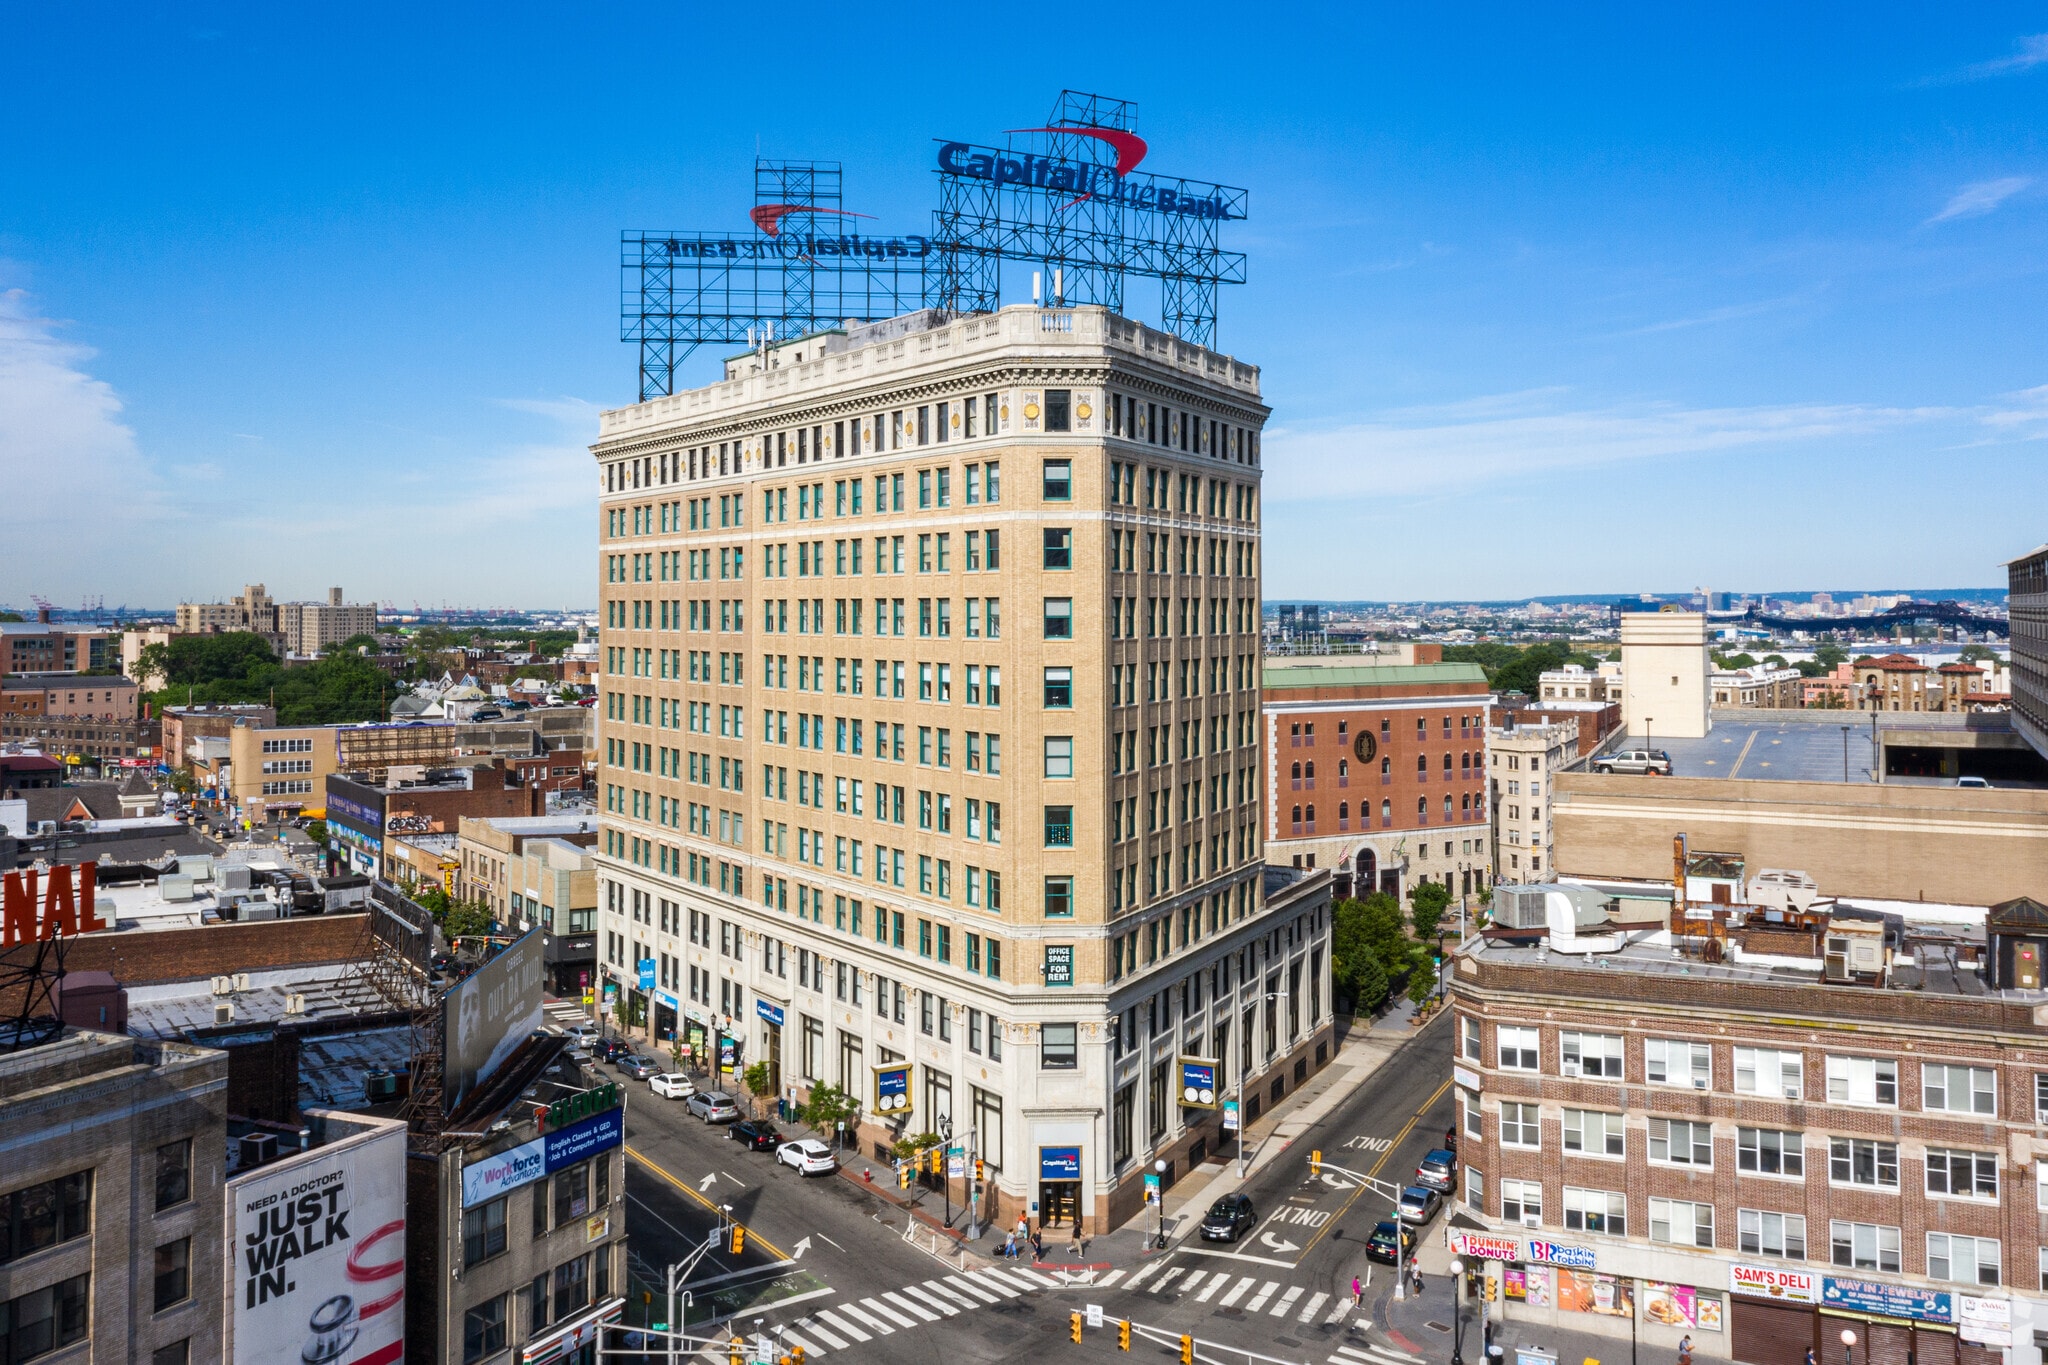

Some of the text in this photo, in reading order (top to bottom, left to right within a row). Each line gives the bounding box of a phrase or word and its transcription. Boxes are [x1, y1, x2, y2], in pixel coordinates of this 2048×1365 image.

[1048, 973, 1070, 981] RENT
[488, 982, 505, 1022] OUT
[508, 971, 519, 1005] DA
[522, 956, 539, 993] MUD
[551, 1121, 611, 1151] English Classes & GED
[551, 1129, 617, 1161] Job & Computer Training
[1343, 1136, 1393, 1152] ONLY
[484, 1153, 541, 1184] Workforce
[501, 1165, 541, 1187] Advantage
[246, 1170, 344, 1213] NEED A DOCTOR?
[246, 1183, 344, 1246] JUST
[1273, 1205, 1331, 1228] ONLY
[245, 1210, 350, 1276] WALK
[1469, 1245, 1516, 1260] DONUTS
[1530, 1241, 1557, 1262] BR
[1557, 1245, 1595, 1258] baskin
[1557, 1255, 1595, 1268] robbins
[246, 1265, 295, 1310] IN.
[1734, 1267, 1811, 1290] SAM'S DELI
[1835, 1279, 1862, 1291] WAY
[1863, 1283, 1877, 1294] IN
